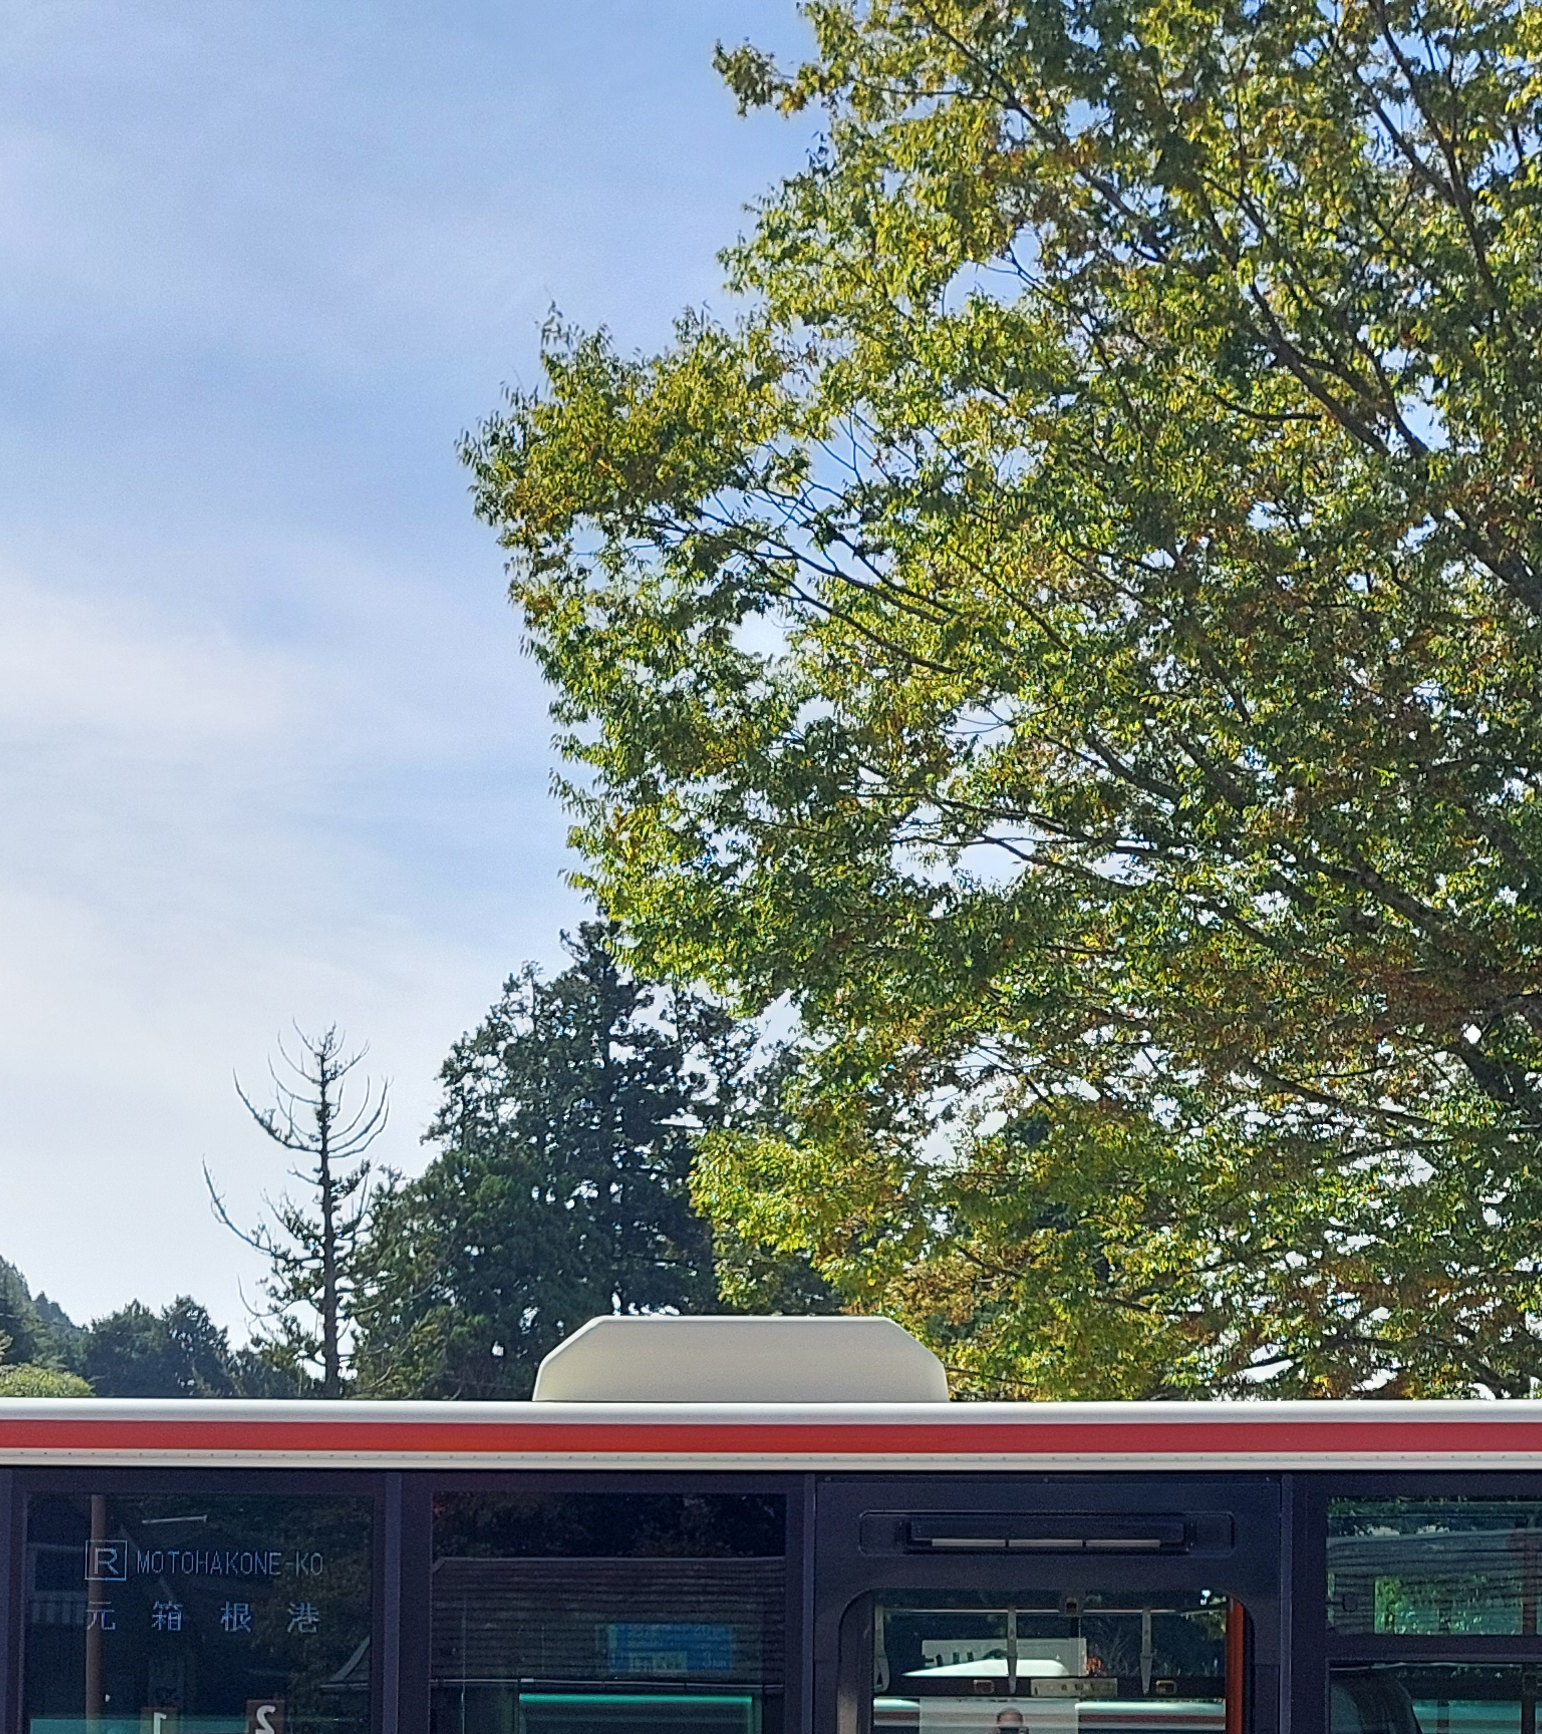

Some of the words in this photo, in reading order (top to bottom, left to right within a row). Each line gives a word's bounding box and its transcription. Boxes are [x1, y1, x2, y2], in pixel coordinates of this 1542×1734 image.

[94, 1547, 120, 1575] R
[135, 1549, 325, 1577] MOTOHAKONE-KO
[86, 1600, 321, 1635] 元箱根港
